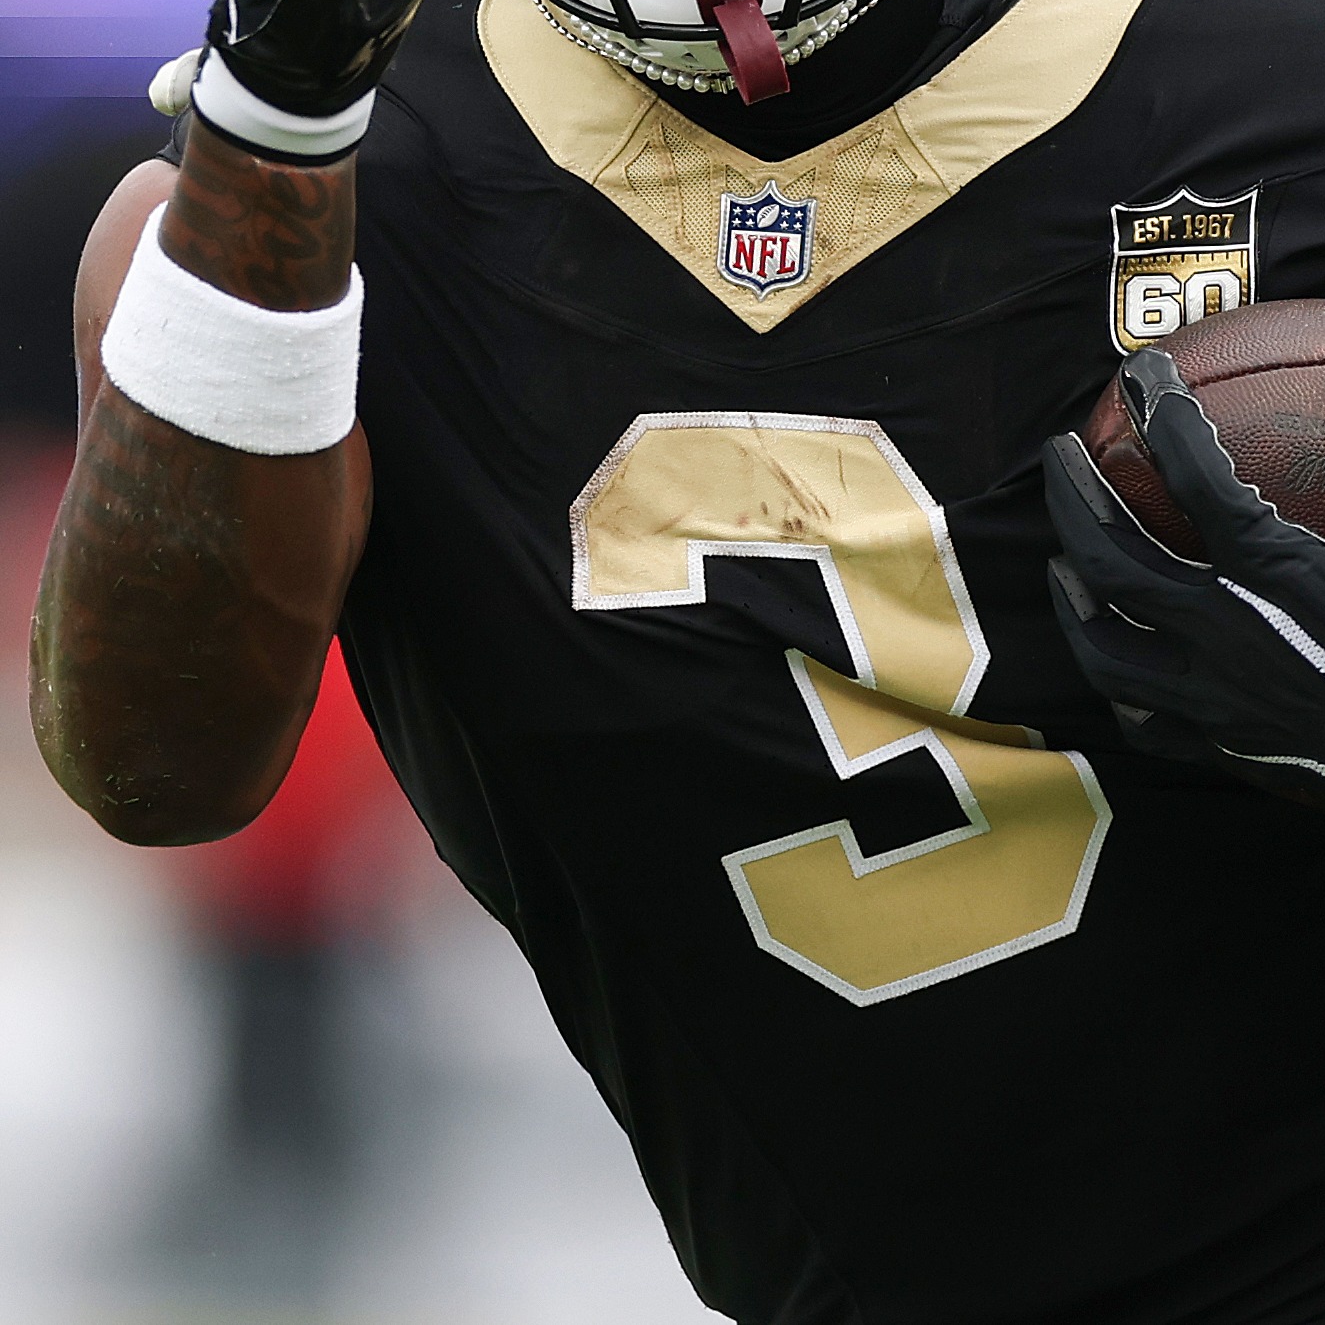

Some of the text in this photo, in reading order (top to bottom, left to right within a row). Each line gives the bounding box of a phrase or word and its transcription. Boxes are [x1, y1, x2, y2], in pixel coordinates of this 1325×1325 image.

[732, 233, 796, 279] NFL
[1133, 213, 1236, 244] EST. 1967
[1123, 268, 1242, 339] 60
[569, 411, 1113, 1007] 3
